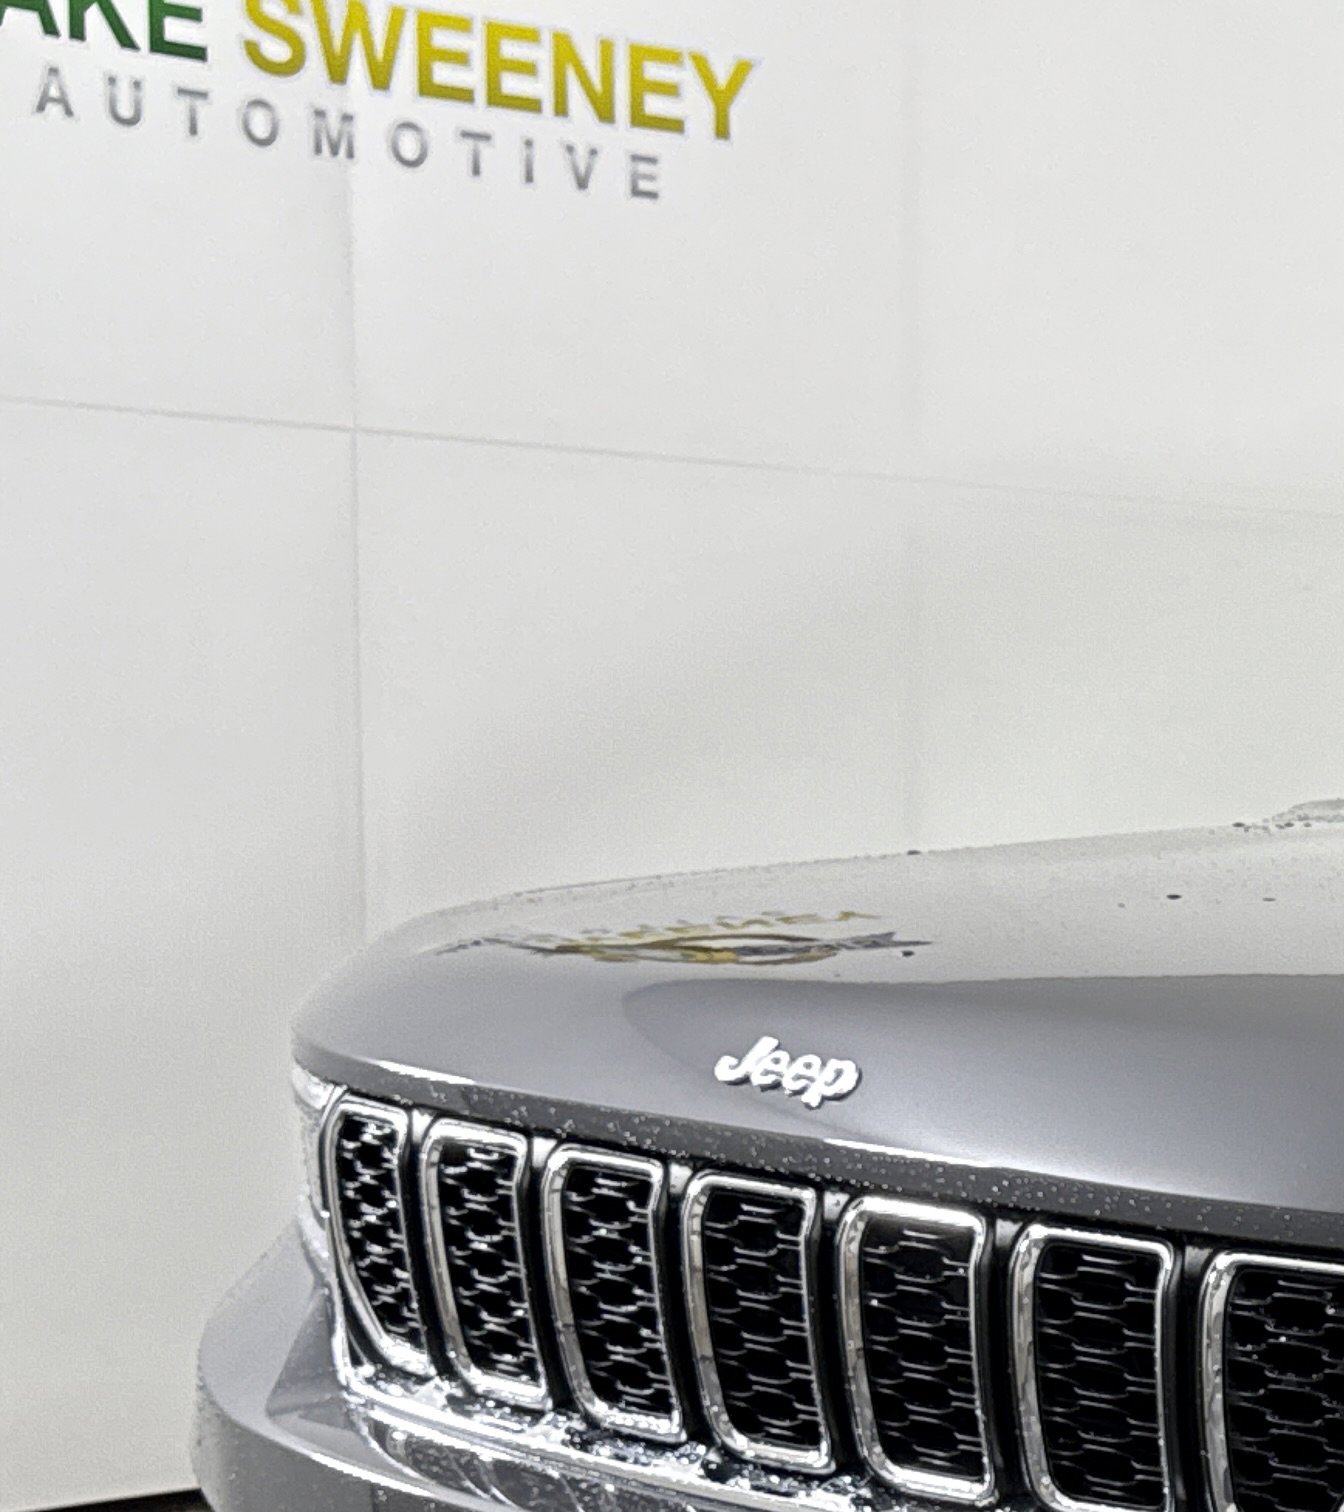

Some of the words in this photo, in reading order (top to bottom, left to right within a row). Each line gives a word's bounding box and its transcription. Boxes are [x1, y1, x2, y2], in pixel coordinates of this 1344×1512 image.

[34, 66, 661, 201] AUTOMOTIVE
[243, 0, 753, 139] SWEENEY
[714, 1035, 863, 1108] Jeep
